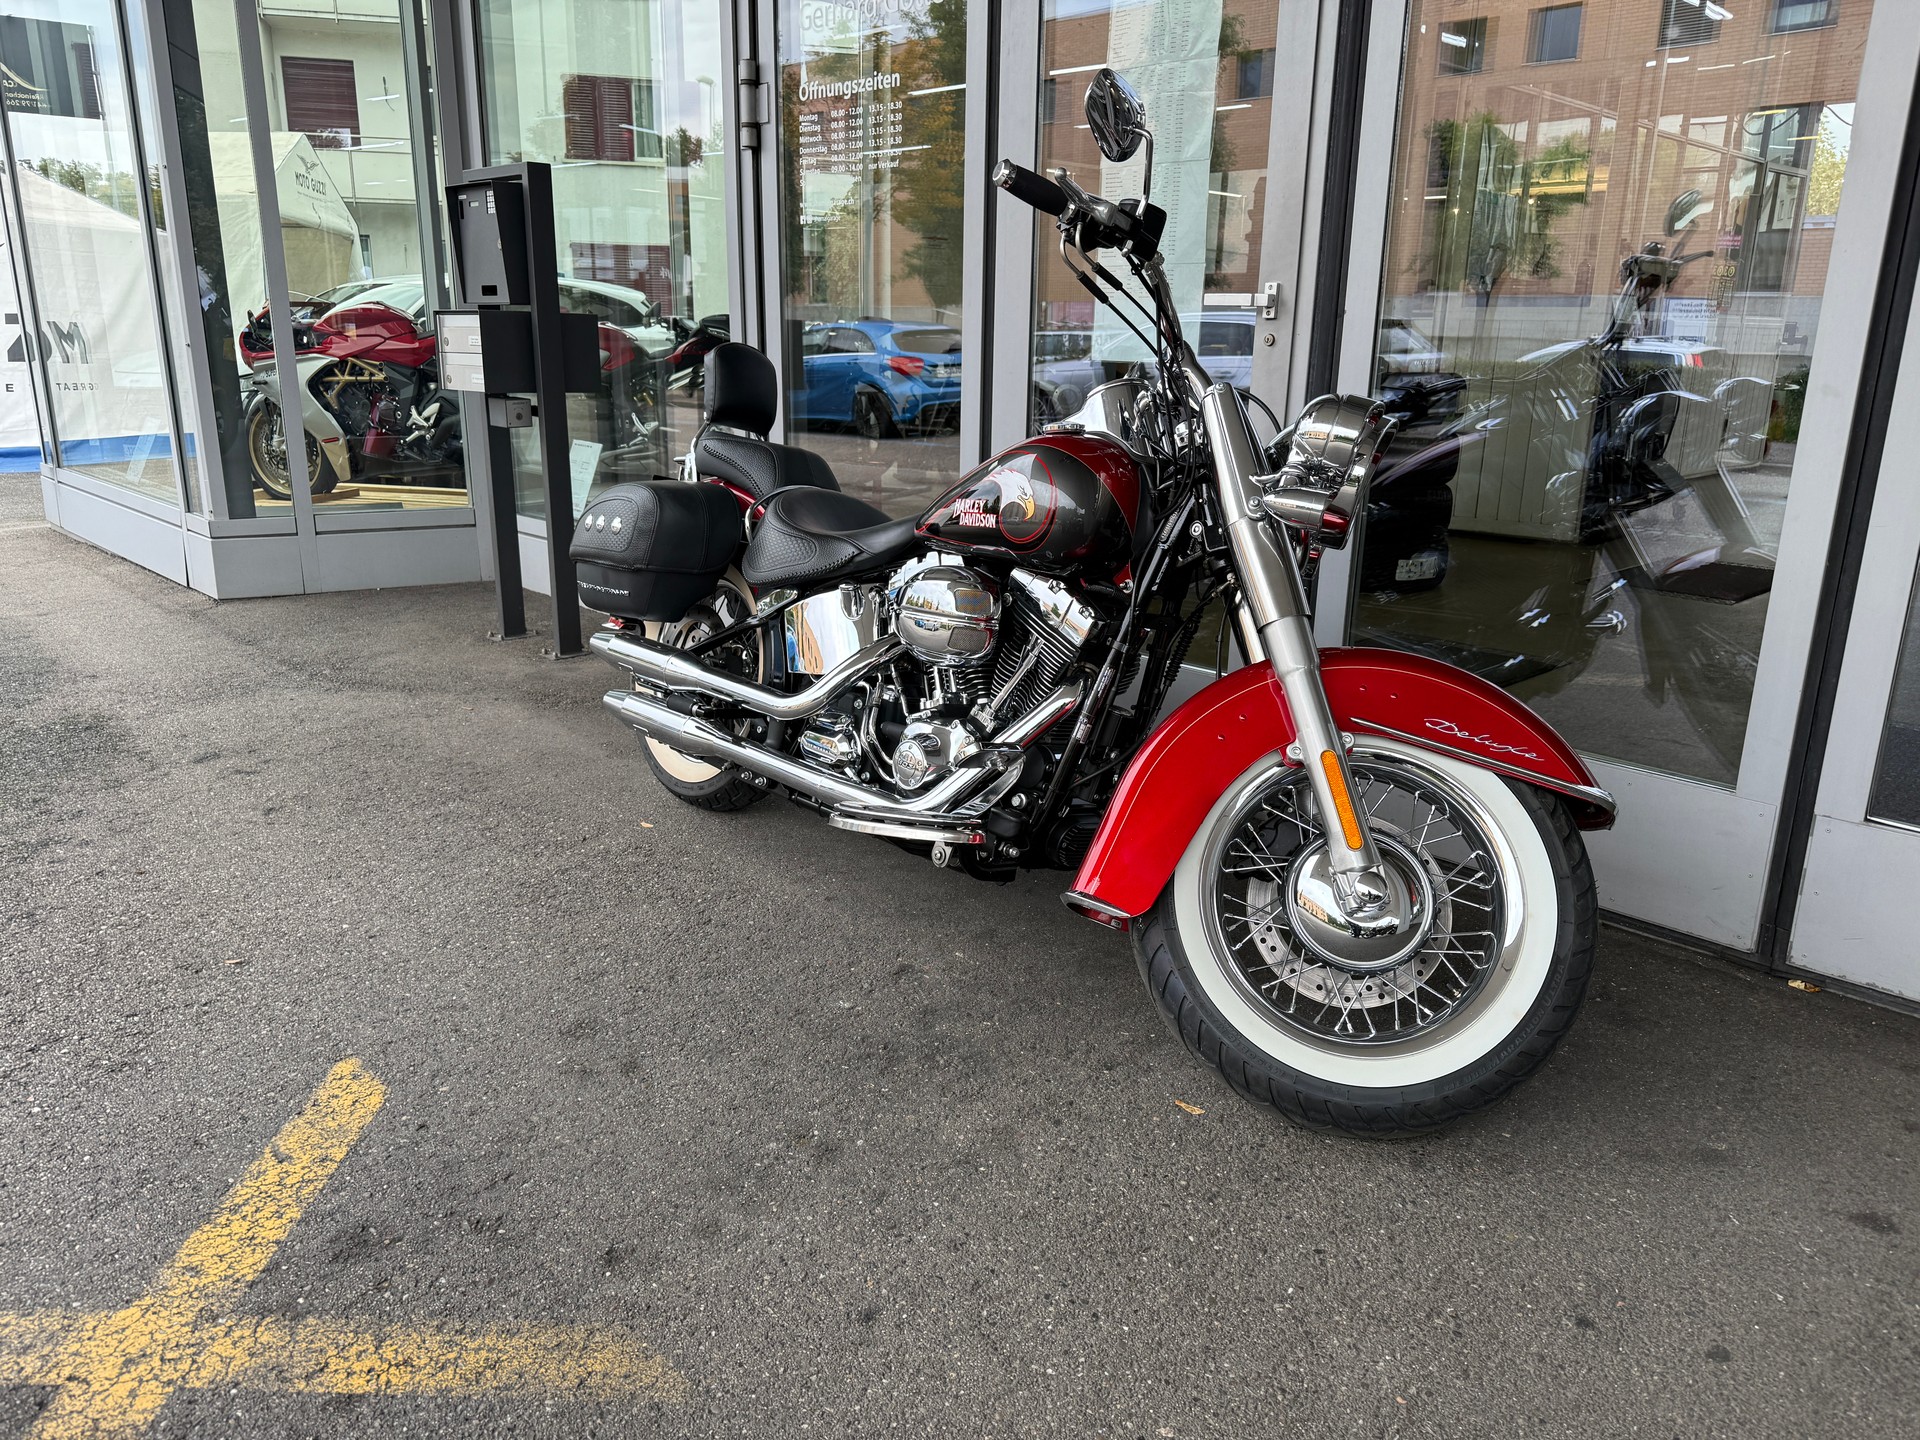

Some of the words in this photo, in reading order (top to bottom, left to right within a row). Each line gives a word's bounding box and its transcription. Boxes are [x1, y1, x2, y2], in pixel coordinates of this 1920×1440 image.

[799, 114, 818, 122] Montag
[953, 498, 987, 518] HARLEY
[959, 512, 997, 528] DAVIDSON
[1423, 718, 1545, 761] Deluxe
